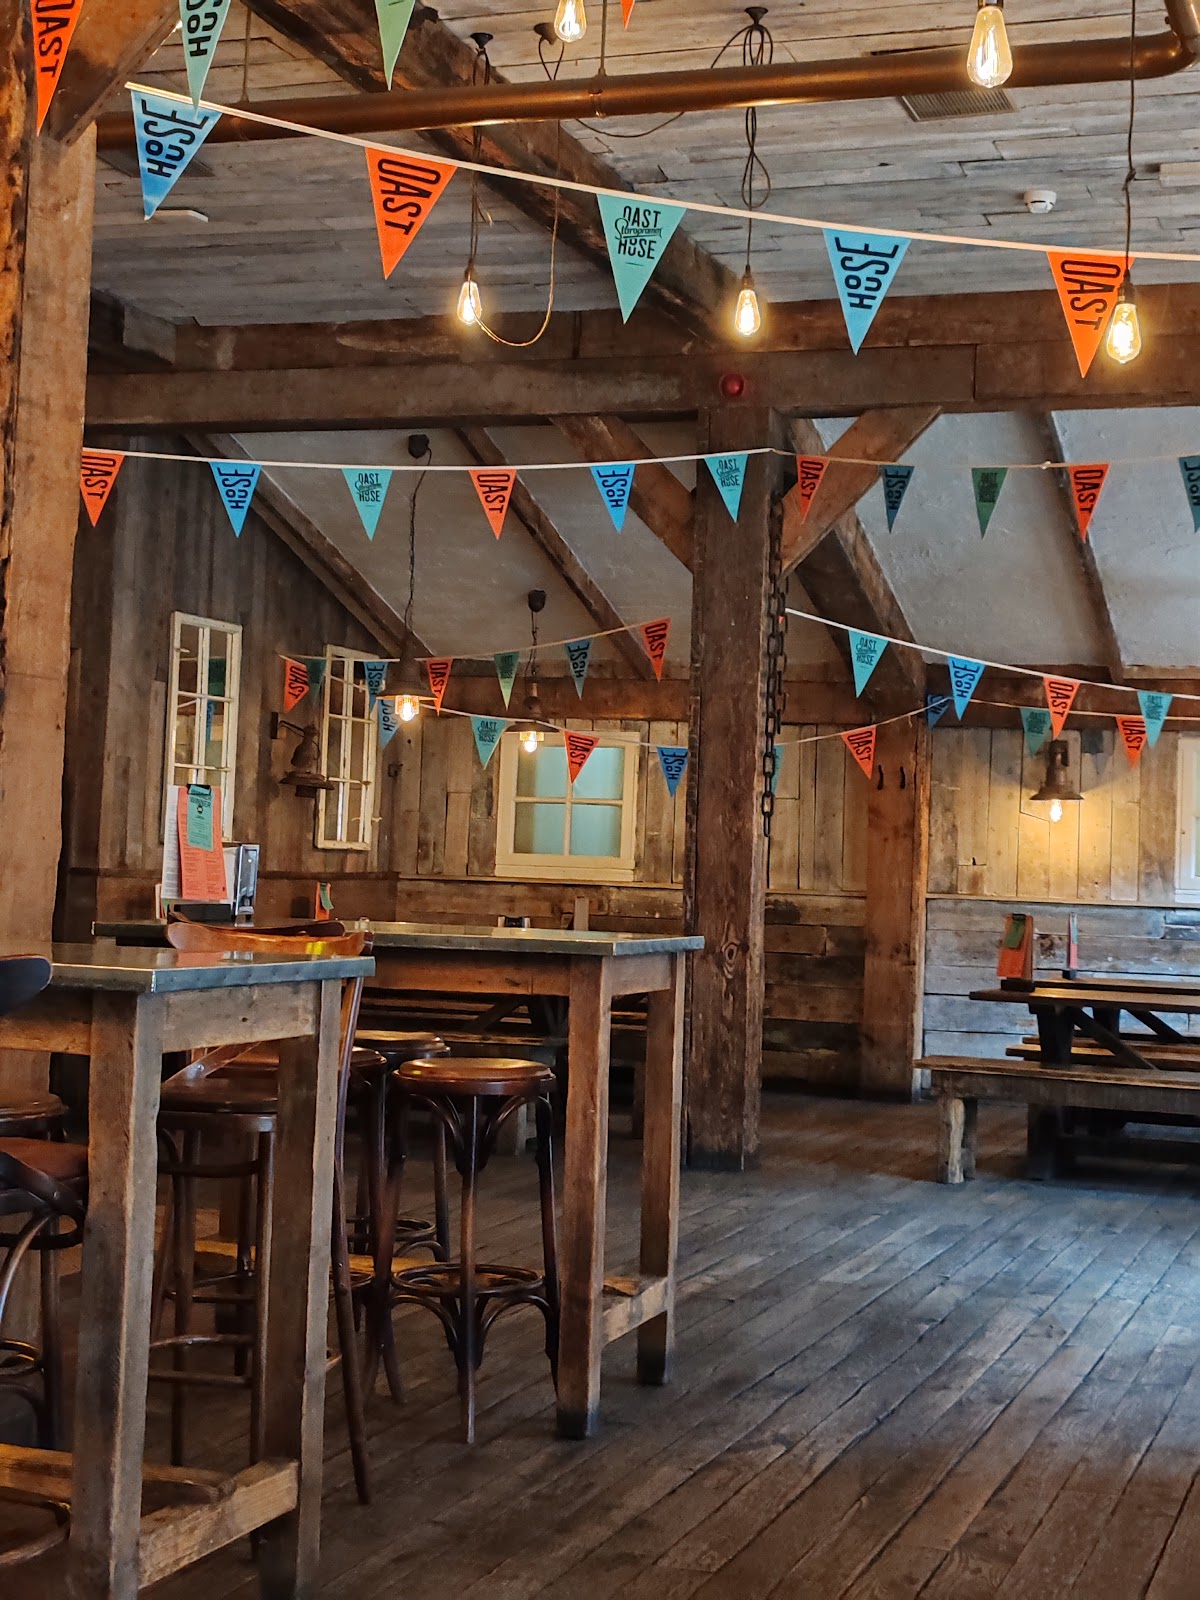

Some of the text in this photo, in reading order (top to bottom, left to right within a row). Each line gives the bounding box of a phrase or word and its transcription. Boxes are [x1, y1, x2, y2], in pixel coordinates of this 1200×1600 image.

[141, 98, 208, 178] HOUSE
[377, 158, 441, 236] OAST
[623, 205, 661, 228] OAST
[617, 238, 657, 260] HOUSE
[835, 236, 899, 310] HOUSE
[1060, 259, 1121, 331] OAST
[81, 455, 117, 500] OAST
[217, 467, 256, 509] HOUSE
[358, 473, 379, 486] OAST
[477, 474, 510, 514] OAST
[597, 467, 630, 508] HOUSE
[800, 460, 824, 500] OAST
[1073, 469, 1103, 514] OAST
[644, 622, 667, 660] OAST
[289, 665, 309, 699] OAST
[429, 662, 448, 695] OAST
[952, 660, 980, 698] HOUSE
[1049, 681, 1074, 717] OAST
[568, 735, 594, 767] OAST
[847, 730, 872, 761] OAST
[1121, 720, 1145, 750] OAST
[661, 749, 688, 780] HOUSE
